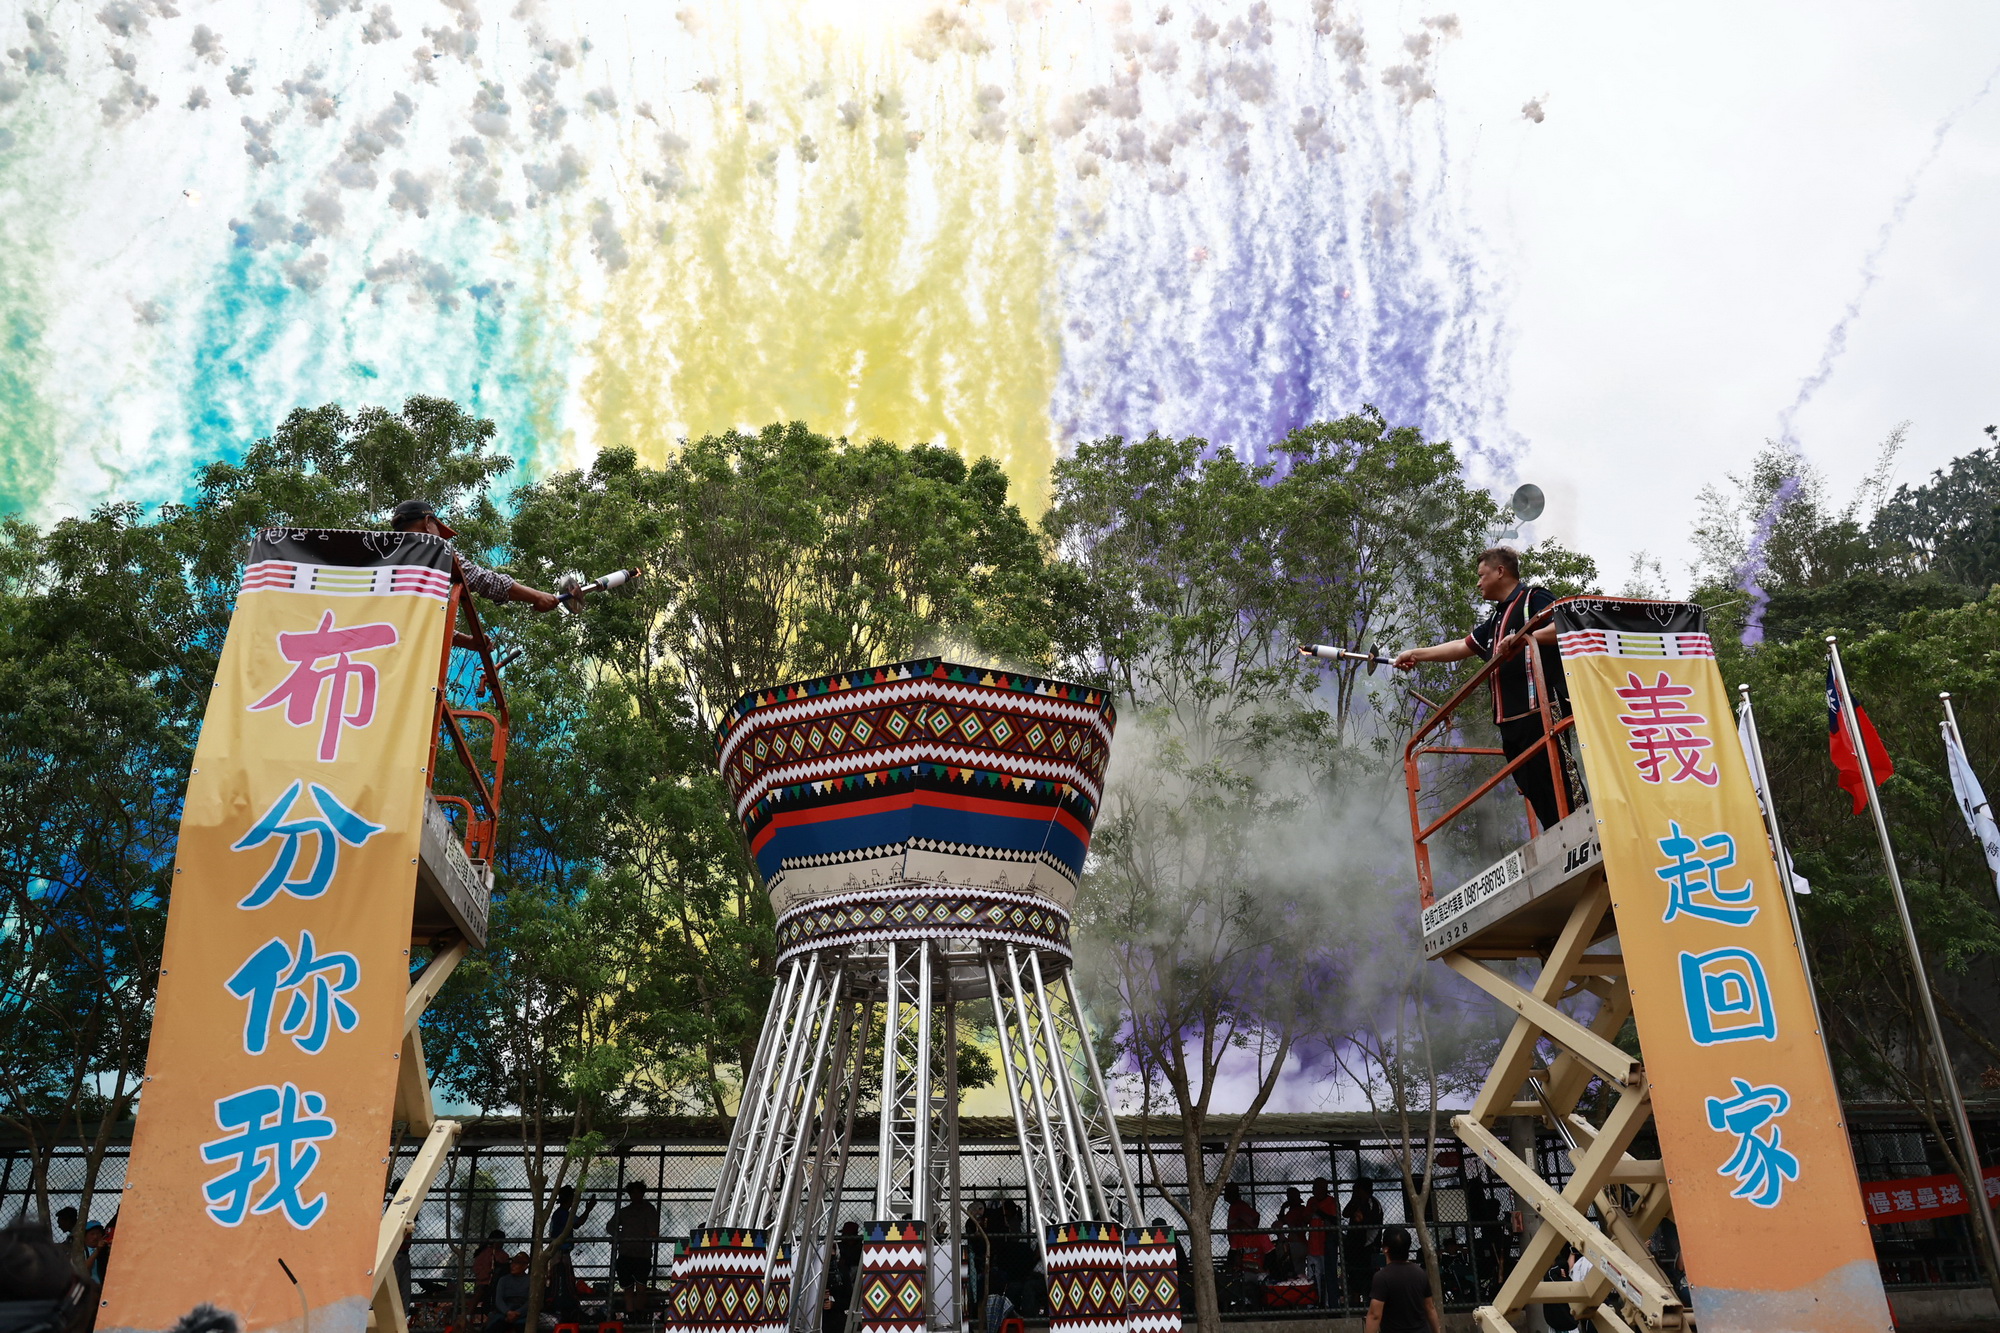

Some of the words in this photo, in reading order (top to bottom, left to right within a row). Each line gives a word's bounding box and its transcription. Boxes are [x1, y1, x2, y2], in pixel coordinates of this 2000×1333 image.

[200, 608, 399, 1230] 布分你我
[1464, 865, 1506, 908] 0987-586793
[1563, 841, 1590, 874] JLG
[1615, 670, 1799, 1209] 義起回家
